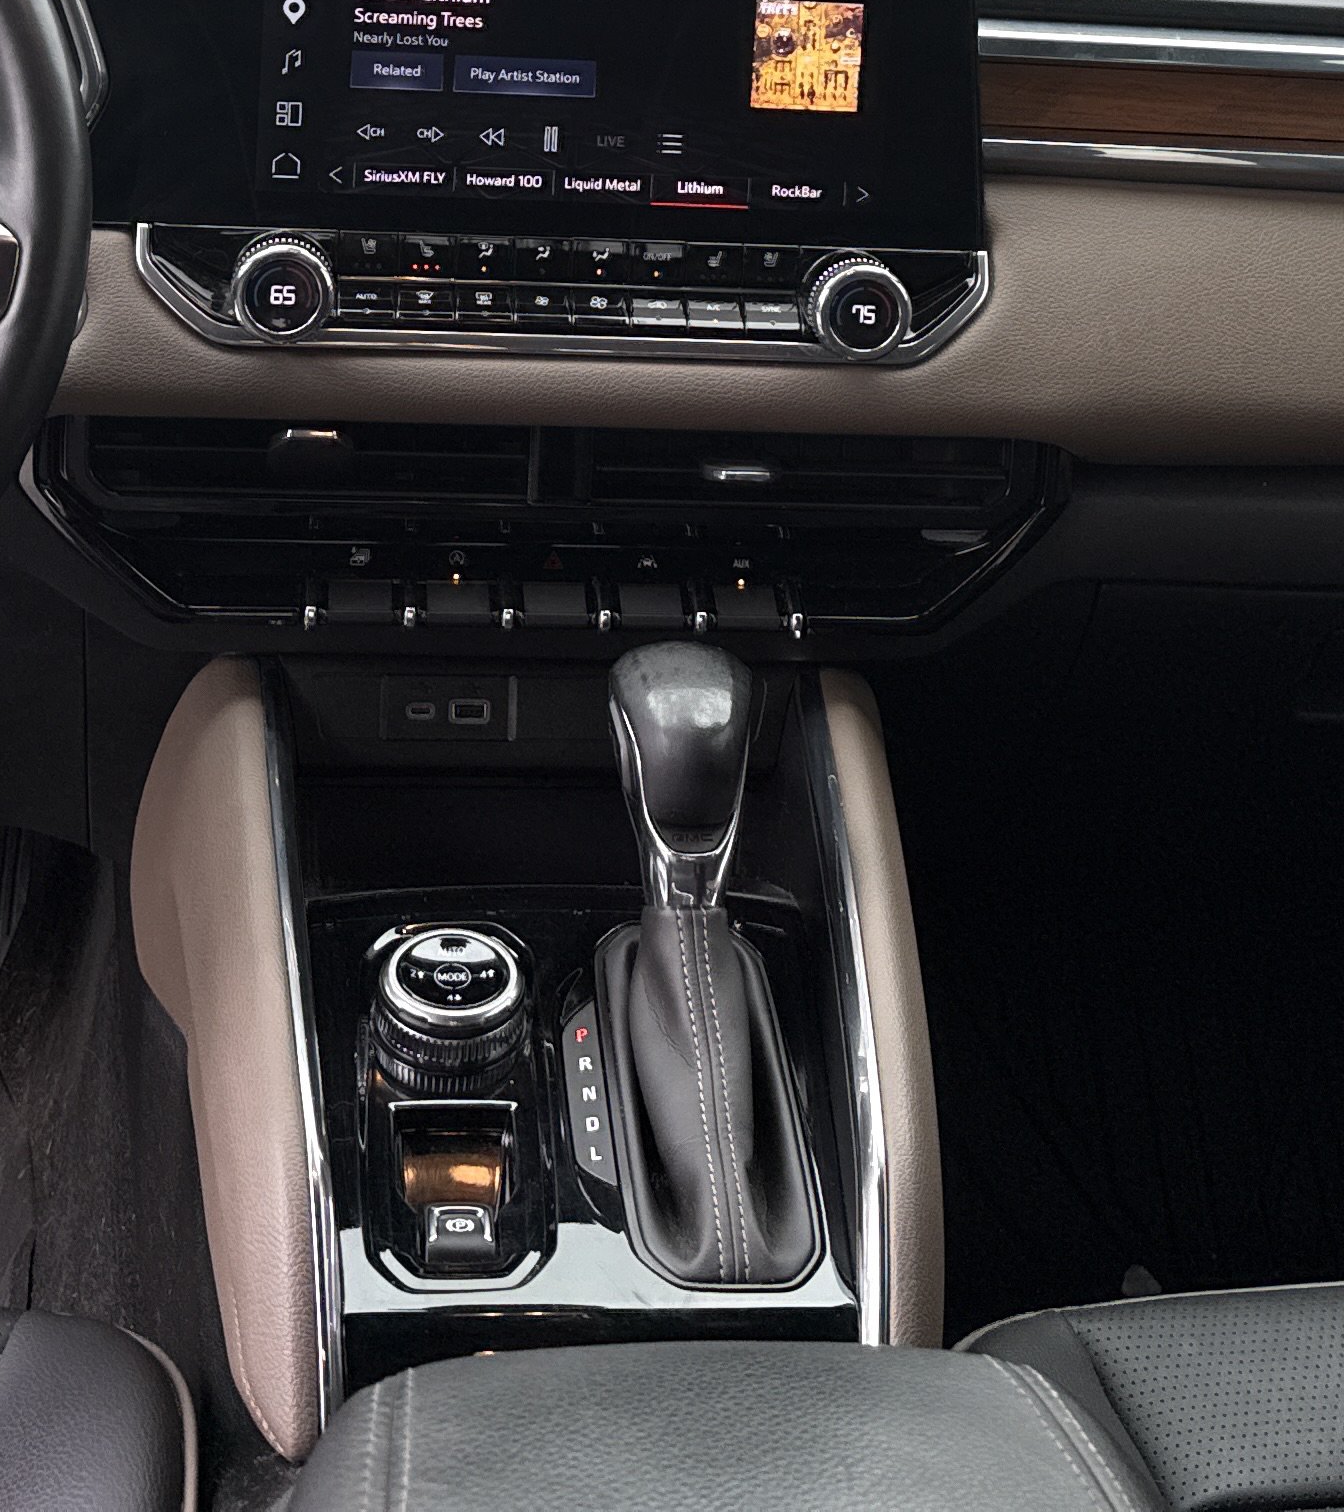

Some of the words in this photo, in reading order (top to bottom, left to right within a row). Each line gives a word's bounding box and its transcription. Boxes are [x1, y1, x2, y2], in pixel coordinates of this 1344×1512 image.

[353, 8, 437, 29] Screaming
[441, 11, 483, 29] Trees
[353, 31, 393, 47] Nearly
[397, 33, 424, 46] Lost
[426, 34, 449, 47] You
[373, 63, 421, 77] Related
[470, 68, 495, 83] Play
[498, 69, 533, 82] Artist
[535, 71, 580, 84] Station
[596, 135, 625, 148] LIVE
[364, 169, 420, 184] SiriusXM
[423, 171, 445, 184] FLY
[466, 173, 514, 187] Howard
[518, 175, 542, 188] 100
[564, 176, 602, 192] Liquid
[605, 179, 641, 192] Metal
[677, 180, 724, 195] Lithium
[771, 184, 822, 199] RockBar
[643, 252, 672, 261] ON/OFF
[270, 285, 296, 305] 65
[355, 292, 377, 300] AUTO
[851, 304, 876, 326] 75
[733, 558, 750, 568] AUX
[437, 972, 468, 982] MODE
[575, 1026, 589, 1043] P
[578, 1056, 593, 1072] R
[581, 1086, 597, 1102] N
[586, 1115, 600, 1132] D
[590, 1146, 603, 1162] L
